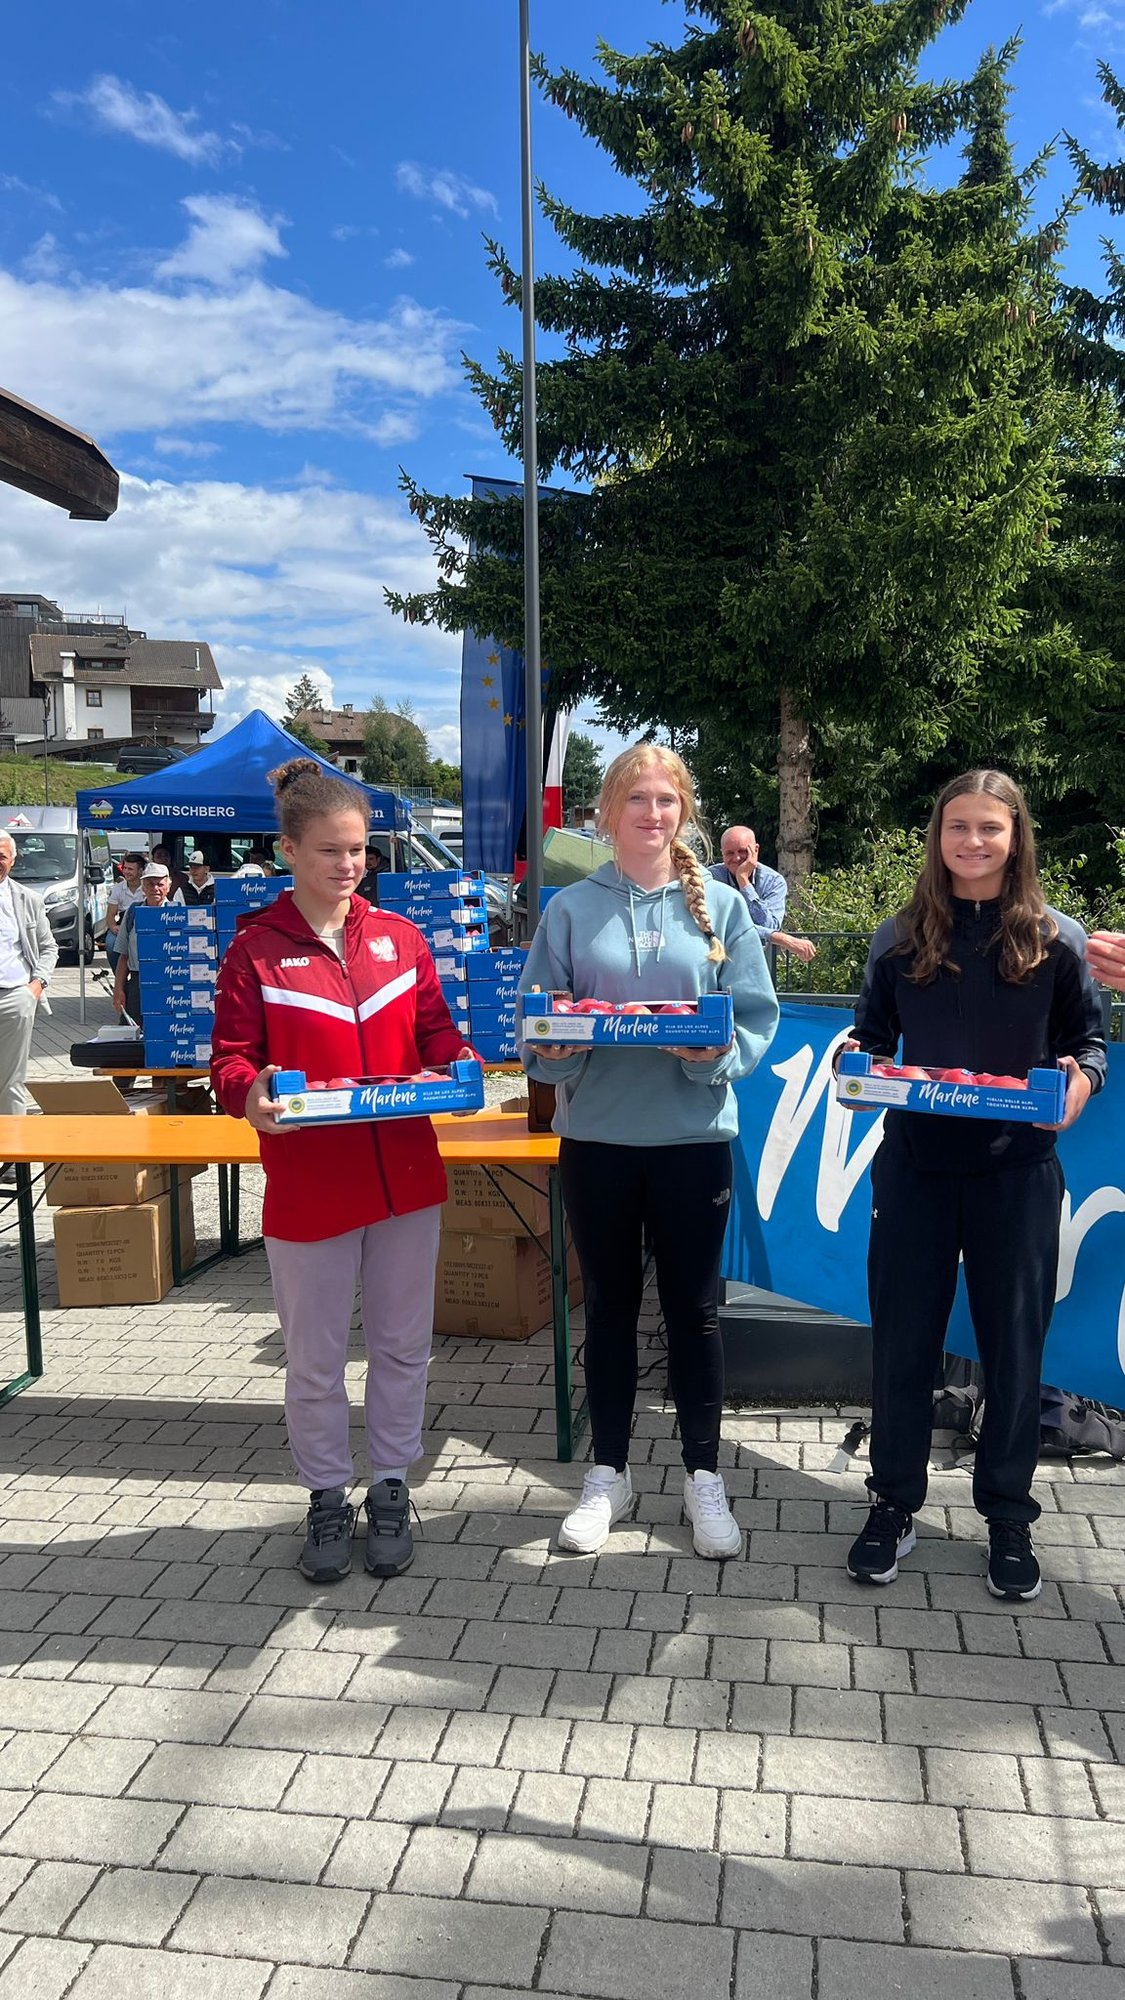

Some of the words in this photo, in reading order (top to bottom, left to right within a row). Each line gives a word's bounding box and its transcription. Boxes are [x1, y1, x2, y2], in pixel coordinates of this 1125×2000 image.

[121, 804, 148, 815] ASV
[150, 805, 235, 817] GITSCHBERG
[280, 956, 310, 968] JAKO
[603, 1016, 659, 1042] Marlene
[360, 1085, 417, 1113] Marlene
[918, 1083, 980, 1109] Marlene
